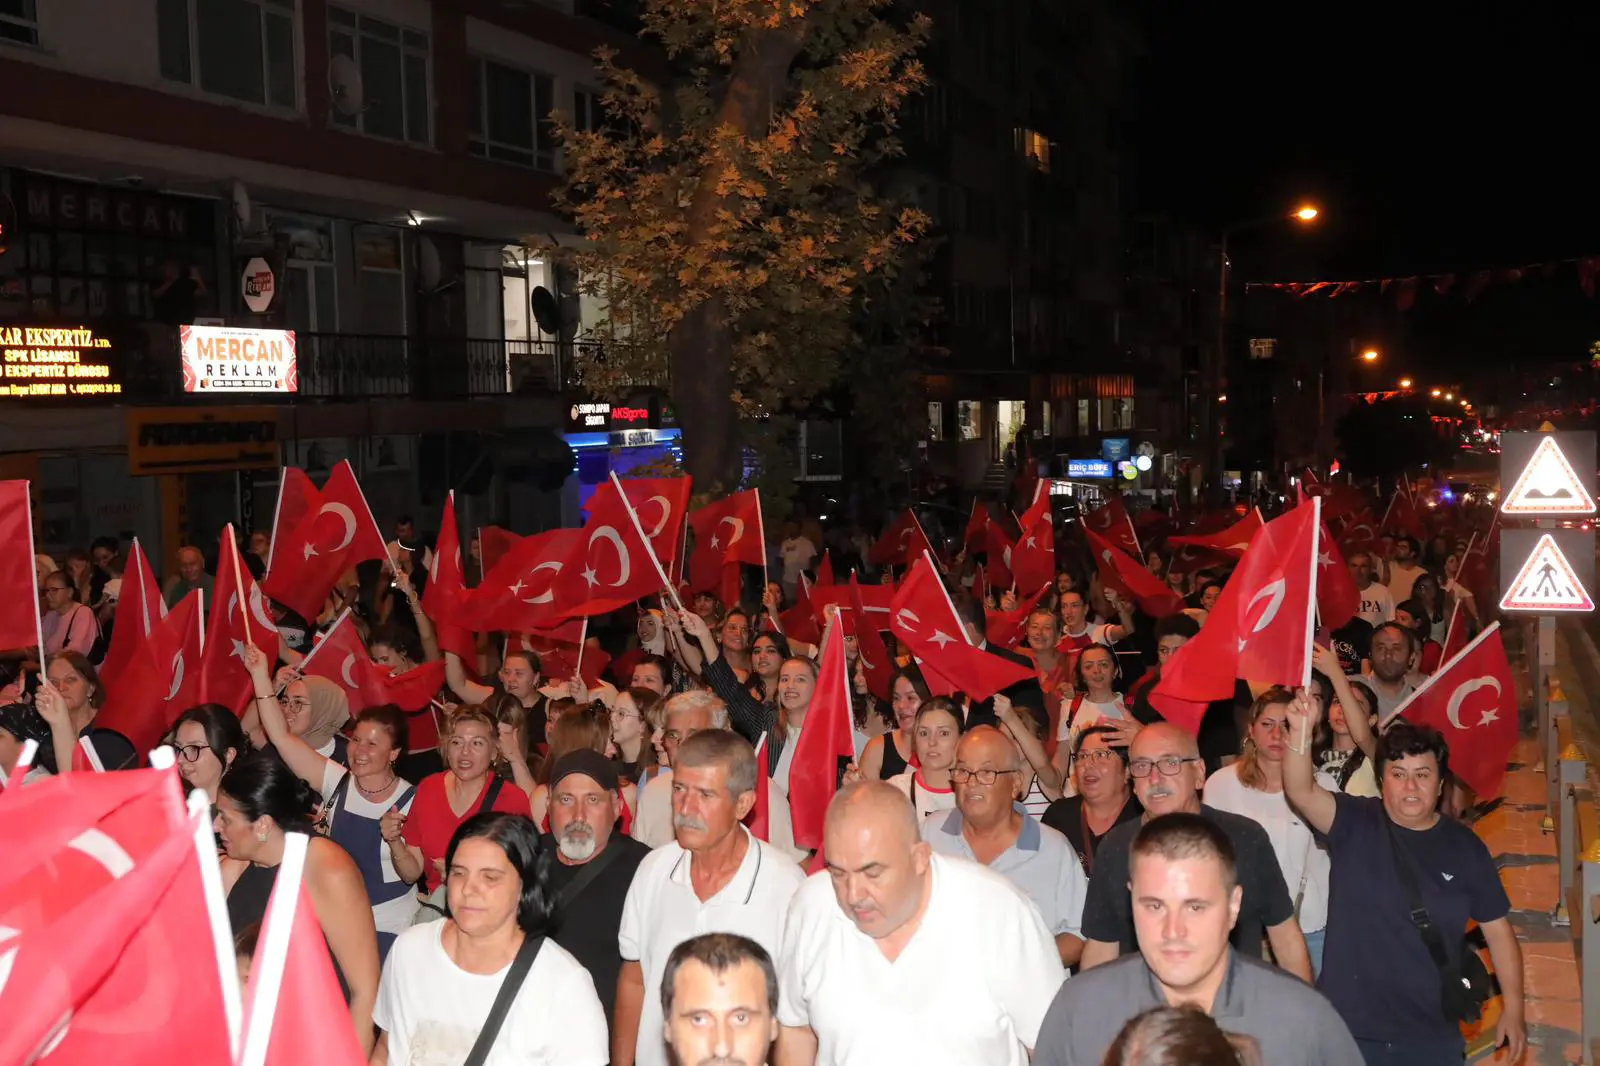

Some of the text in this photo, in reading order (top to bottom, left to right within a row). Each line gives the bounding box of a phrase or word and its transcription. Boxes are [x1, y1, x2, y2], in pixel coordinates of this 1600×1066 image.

[27, 187, 186, 234] MERCAN
[25, 325, 93, 347] EKSPERTİZ
[94, 338, 112, 348] LTD.
[4, 347, 80, 363] SPK LİSANSLI
[196, 336, 283, 362] MERCAN
[5, 363, 66, 378] EKSPERTİZ
[66, 363, 109, 378] BÜROSU
[206, 363, 277, 377] REKLAM
[578, 404, 596, 414] SOMPO
